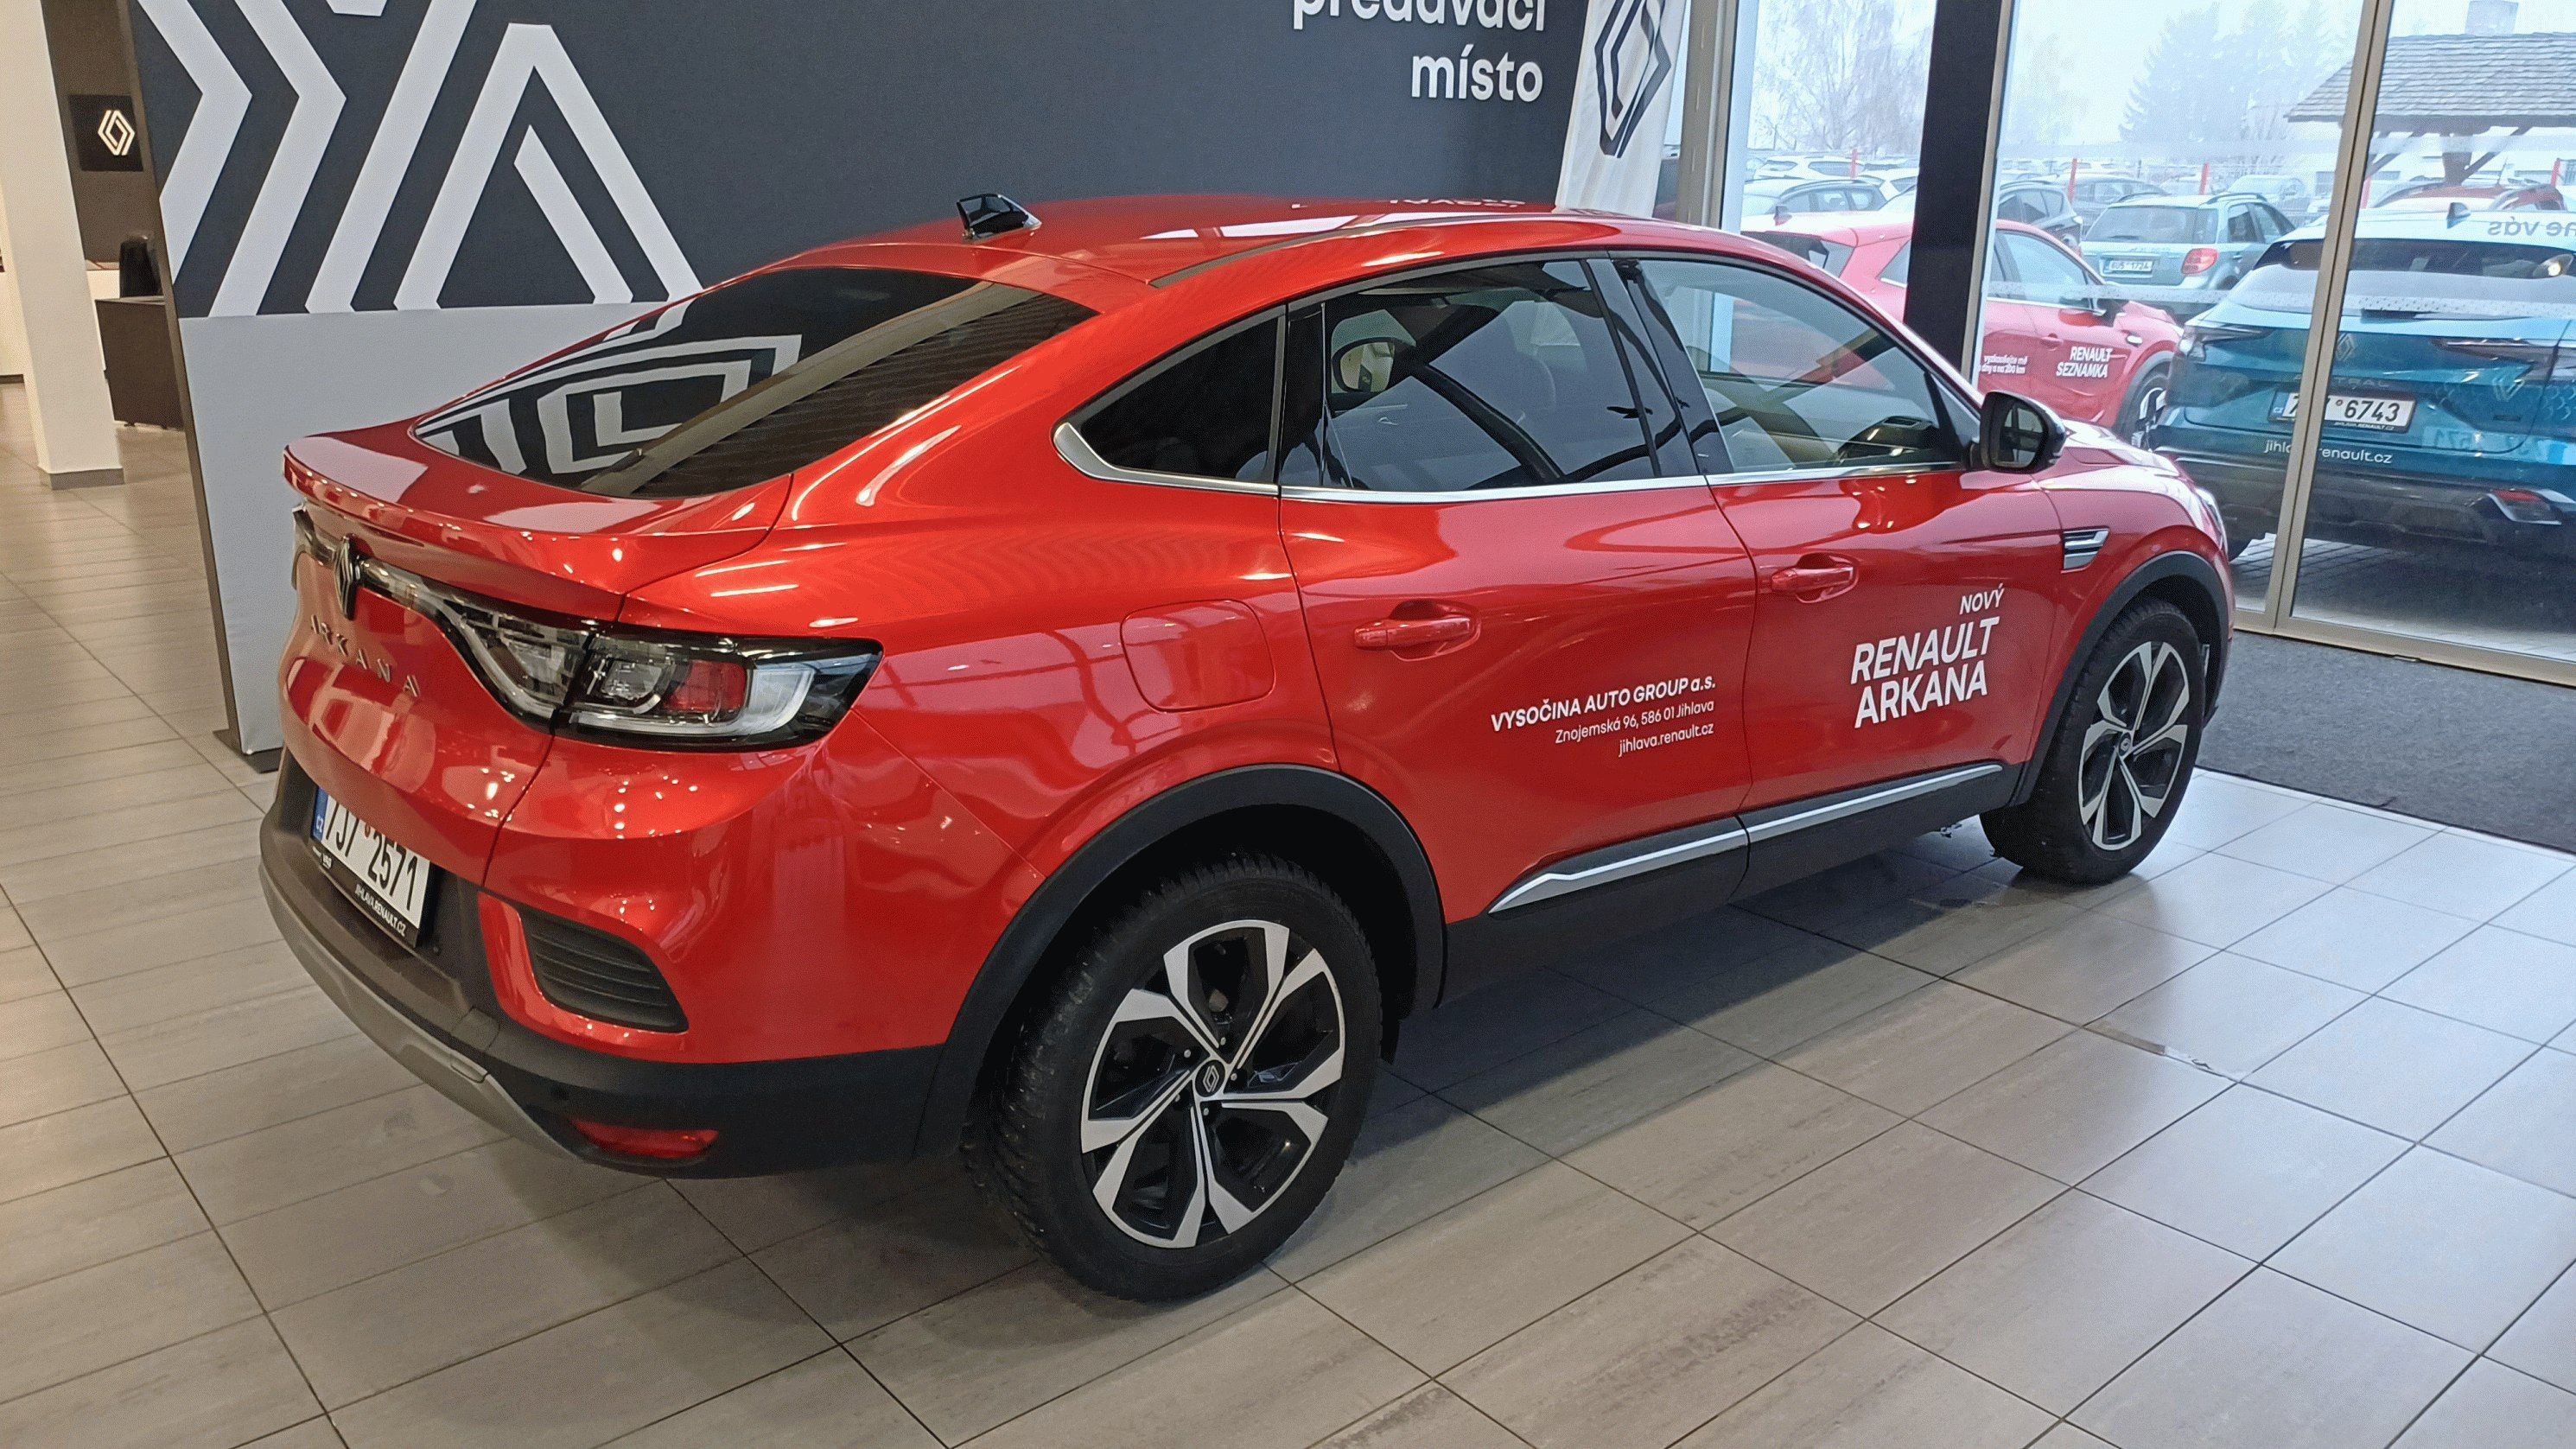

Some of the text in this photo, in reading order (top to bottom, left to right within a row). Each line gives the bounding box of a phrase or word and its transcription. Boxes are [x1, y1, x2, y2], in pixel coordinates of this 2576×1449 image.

[1411, 43, 1543, 102] místo
[2056, 362, 2109, 378] SEZNAMKA
[2070, 346, 2113, 362] RENAULT
[2344, 399, 2401, 423] 6743
[1959, 582, 2005, 614] NOVÝ
[311, 614, 421, 697] ARKANA
[1850, 616, 2000, 684] RENAULT
[1491, 675, 1716, 733] VYSOČINA AUTO GROUP a.s.
[1854, 660, 1988, 728] ARKANA
[1555, 701, 1714, 744] Znojemská 96, 586 01 Jihlava
[1619, 723, 1714, 757] jihlava.renault.cz
[367, 830, 418, 911] 2571
